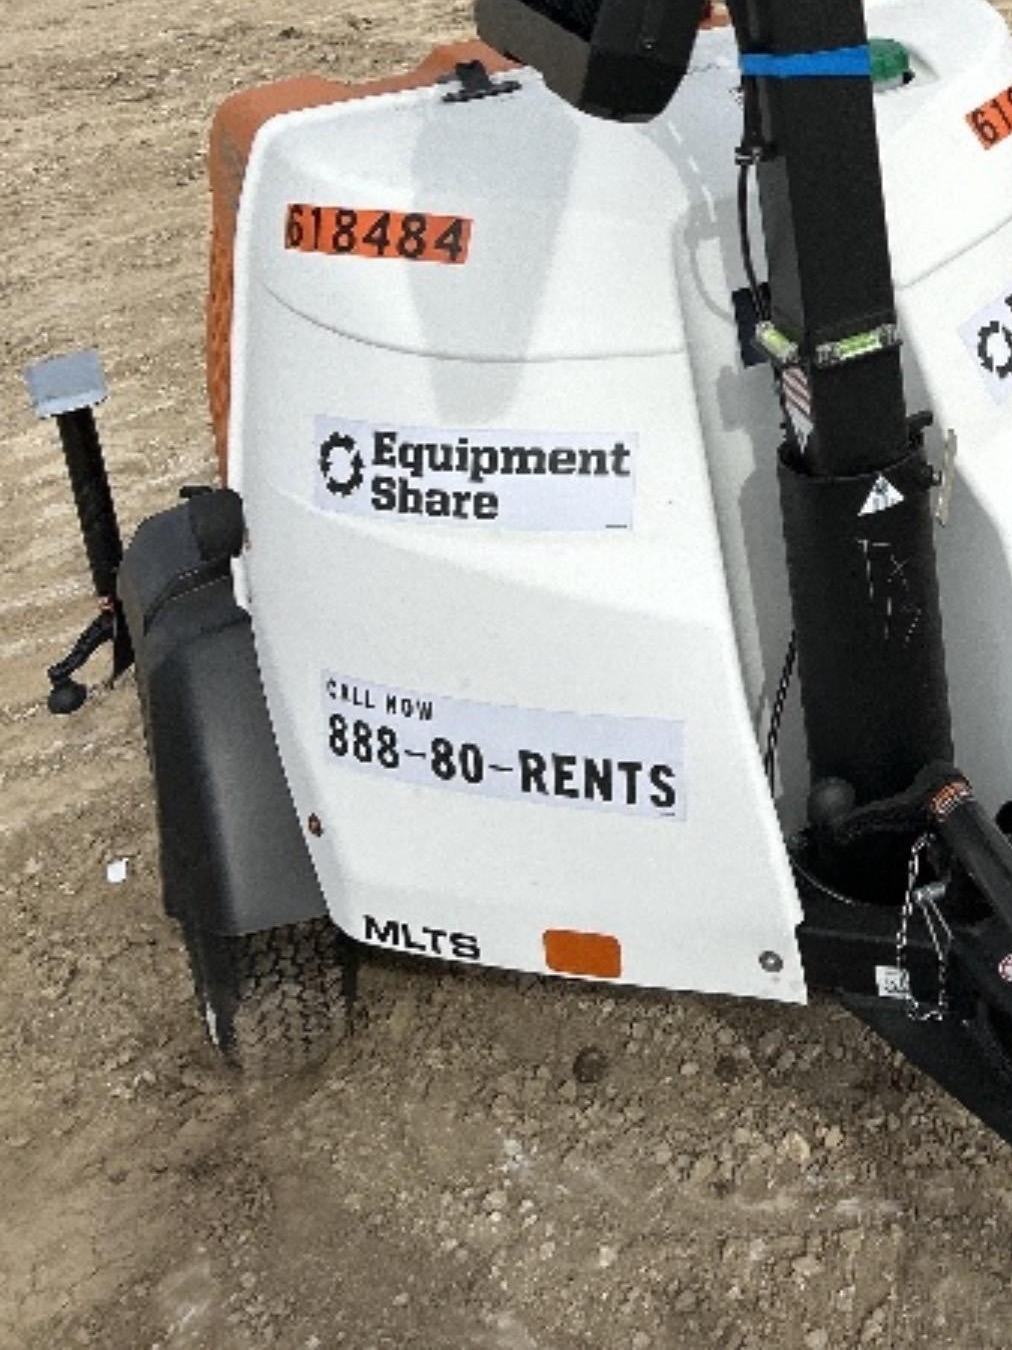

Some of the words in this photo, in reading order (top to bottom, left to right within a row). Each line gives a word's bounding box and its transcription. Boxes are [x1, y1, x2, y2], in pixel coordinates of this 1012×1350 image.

[285, 203, 464, 261] 618484
[371, 431, 631, 483] Equipment
[371, 476, 499, 520] Share
[326, 678, 375, 709] CALL
[386, 694, 433, 721] NOW
[328, 713, 676, 808] 888-80-RENTS
[363, 914, 481, 960] MLTS
